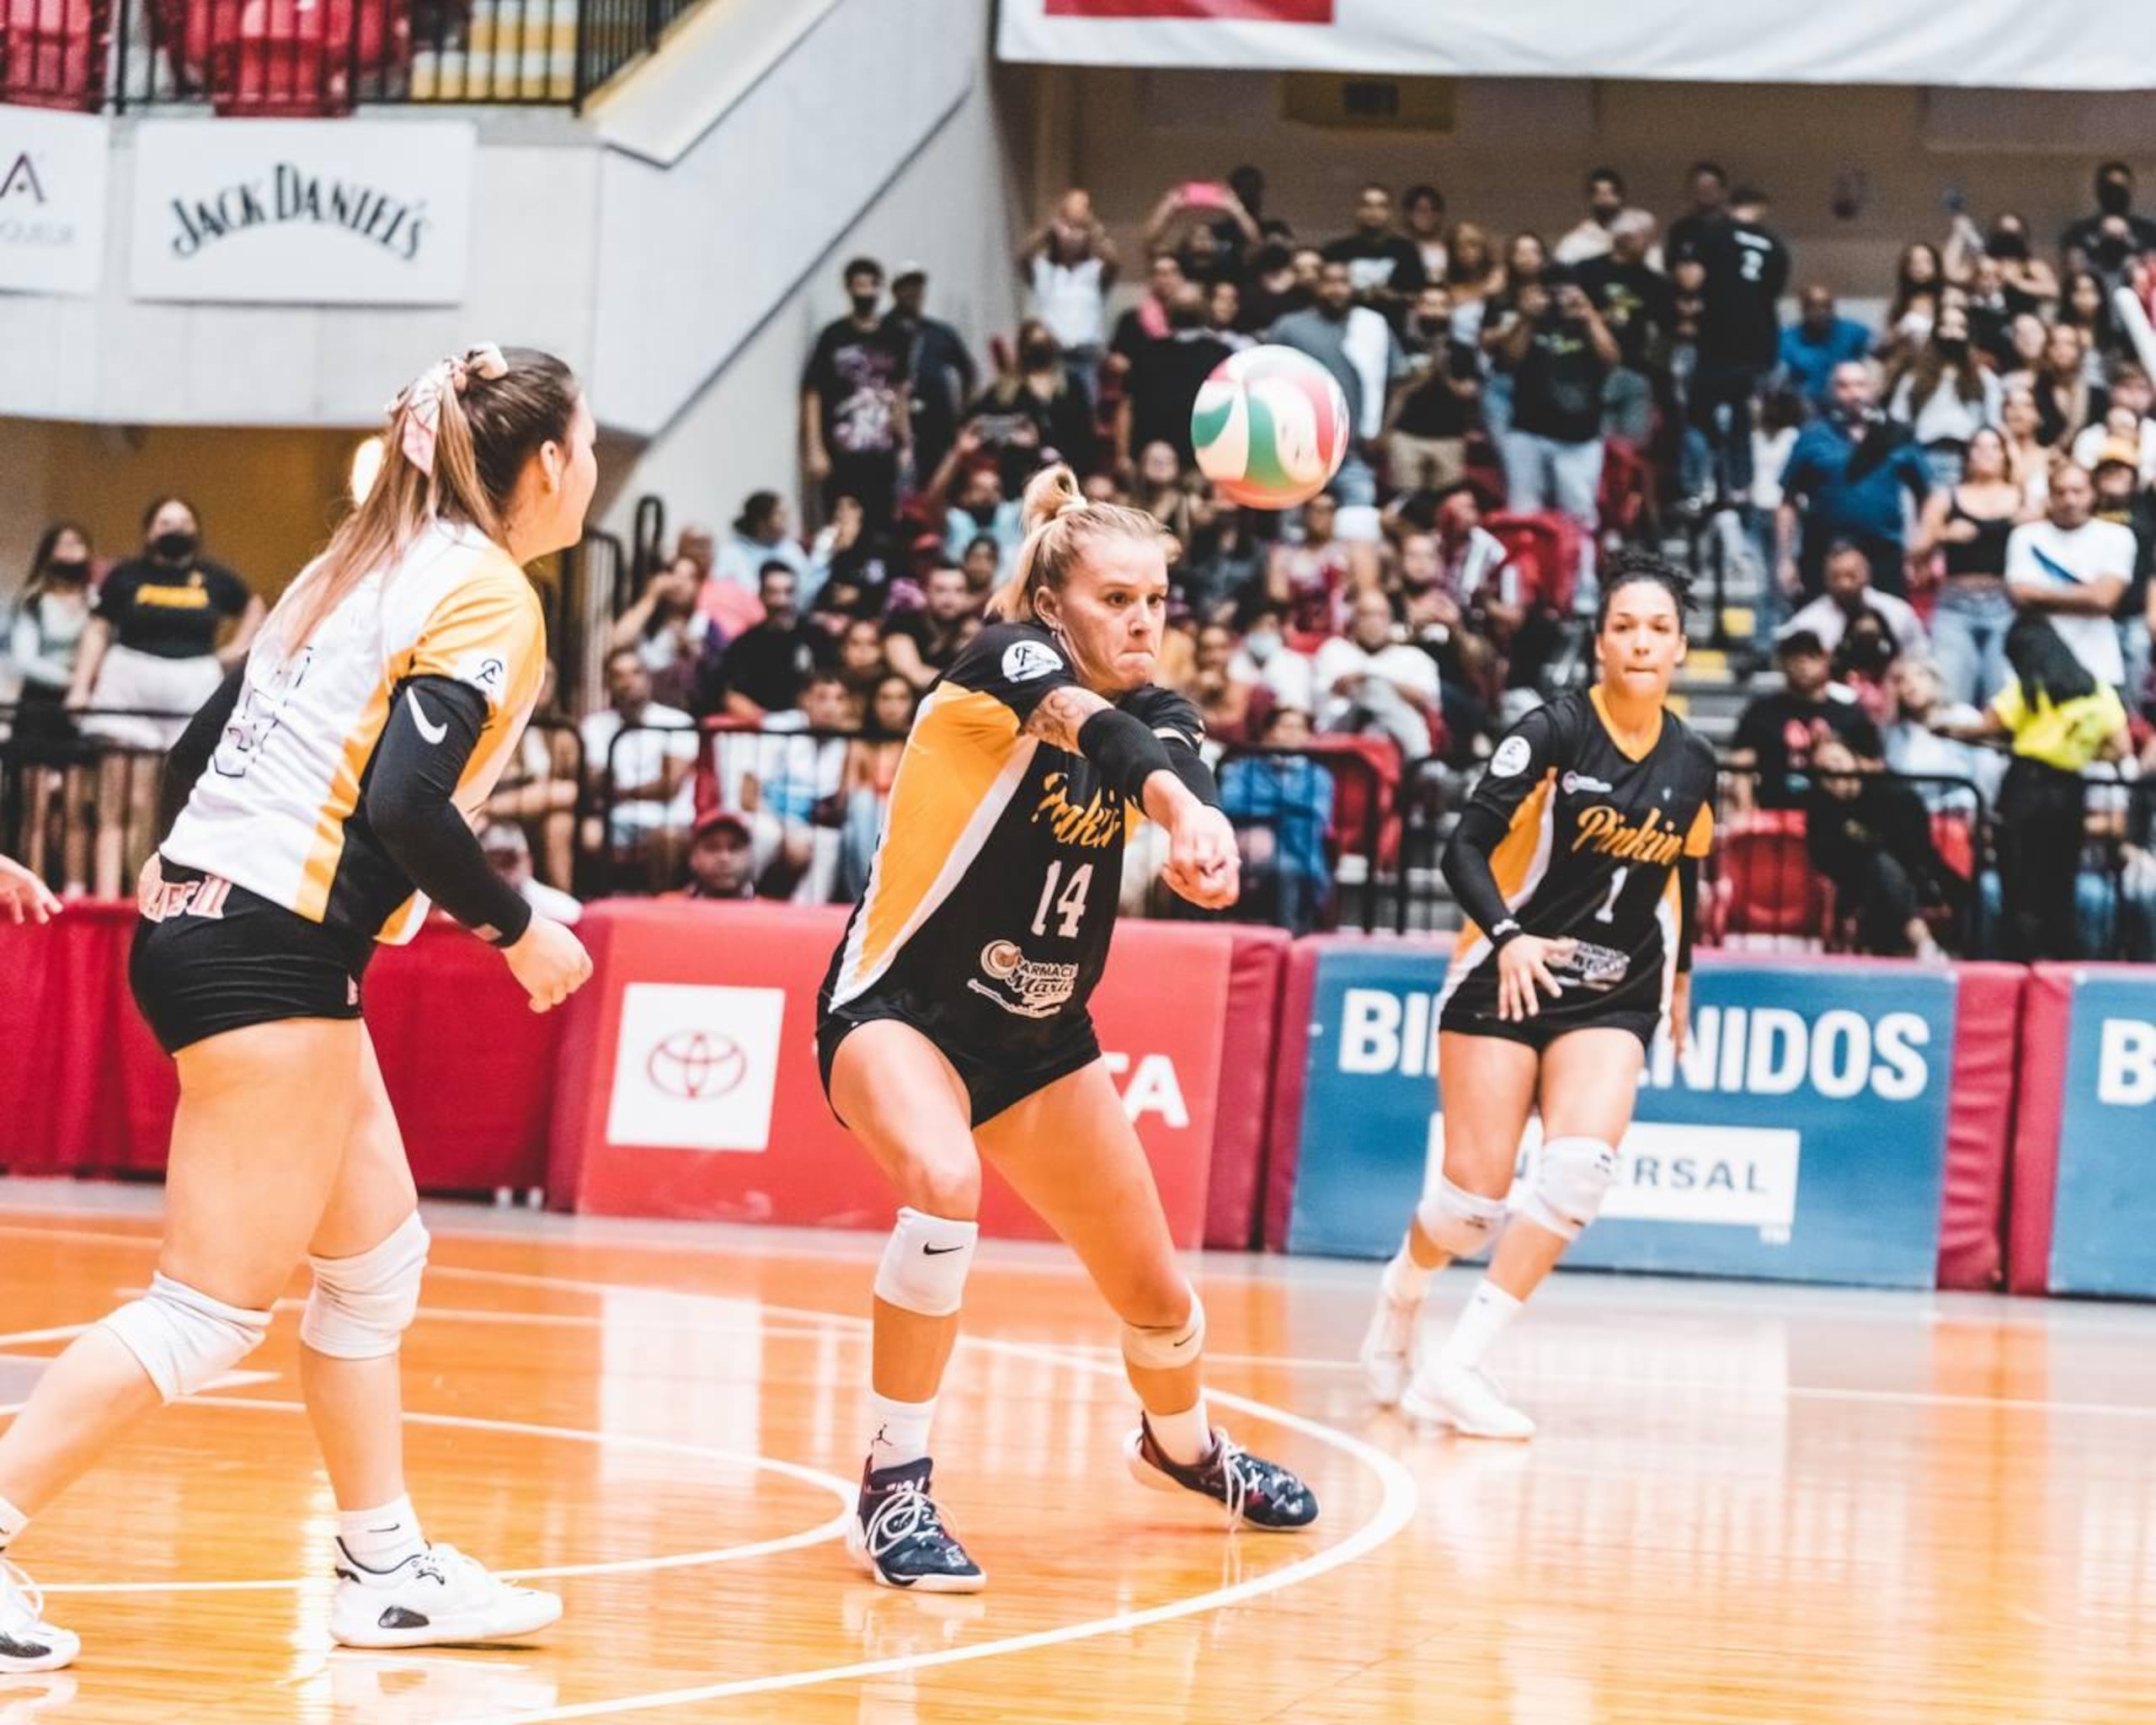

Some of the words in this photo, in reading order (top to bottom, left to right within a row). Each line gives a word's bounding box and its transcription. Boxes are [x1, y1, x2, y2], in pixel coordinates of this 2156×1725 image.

[171, 179, 266, 258] JACK
[275, 163, 427, 260] DANIEL'S
[1572, 805, 1684, 866] Pinkin
[1031, 860, 1094, 938] 14
[1594, 865, 1629, 924] 1
